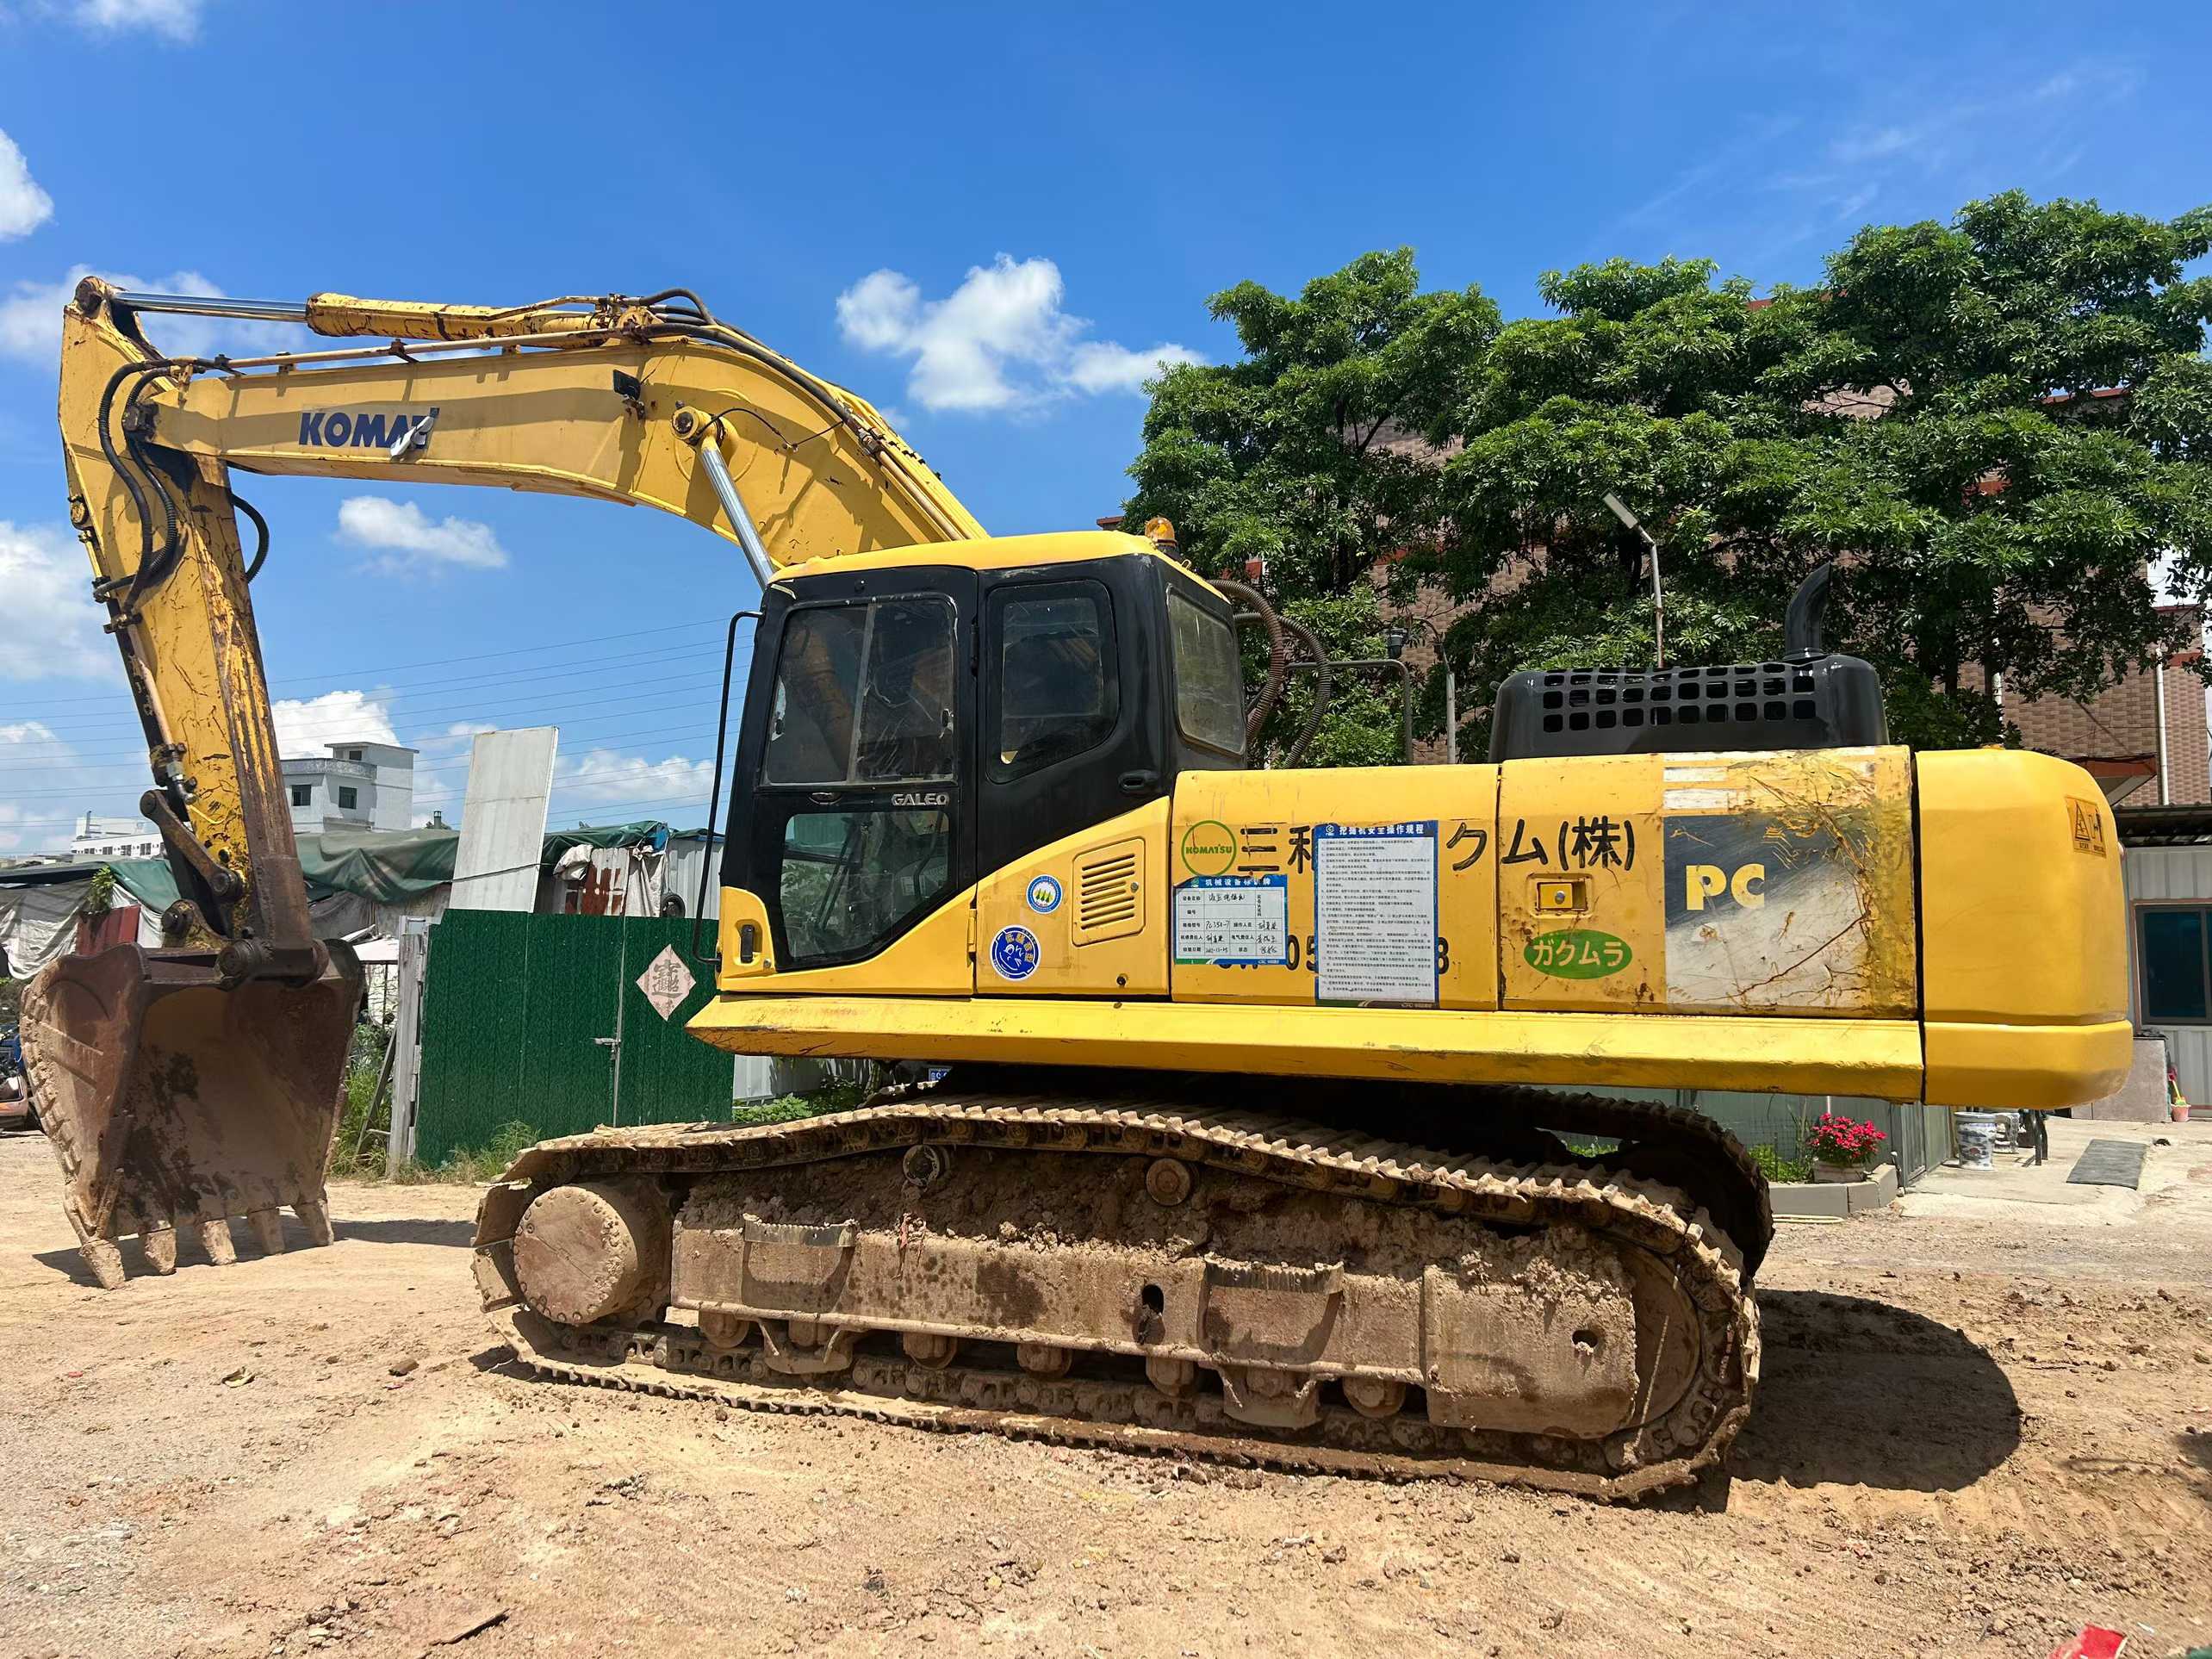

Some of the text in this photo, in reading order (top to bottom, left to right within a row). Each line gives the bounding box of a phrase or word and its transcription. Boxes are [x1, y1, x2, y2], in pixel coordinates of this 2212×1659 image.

[892, 793, 950, 805] GALEO
[1186, 845, 1233, 854] KOMATSU
[1686, 863, 1765, 910] PC
[1533, 939, 1624, 966] ガクムラ
